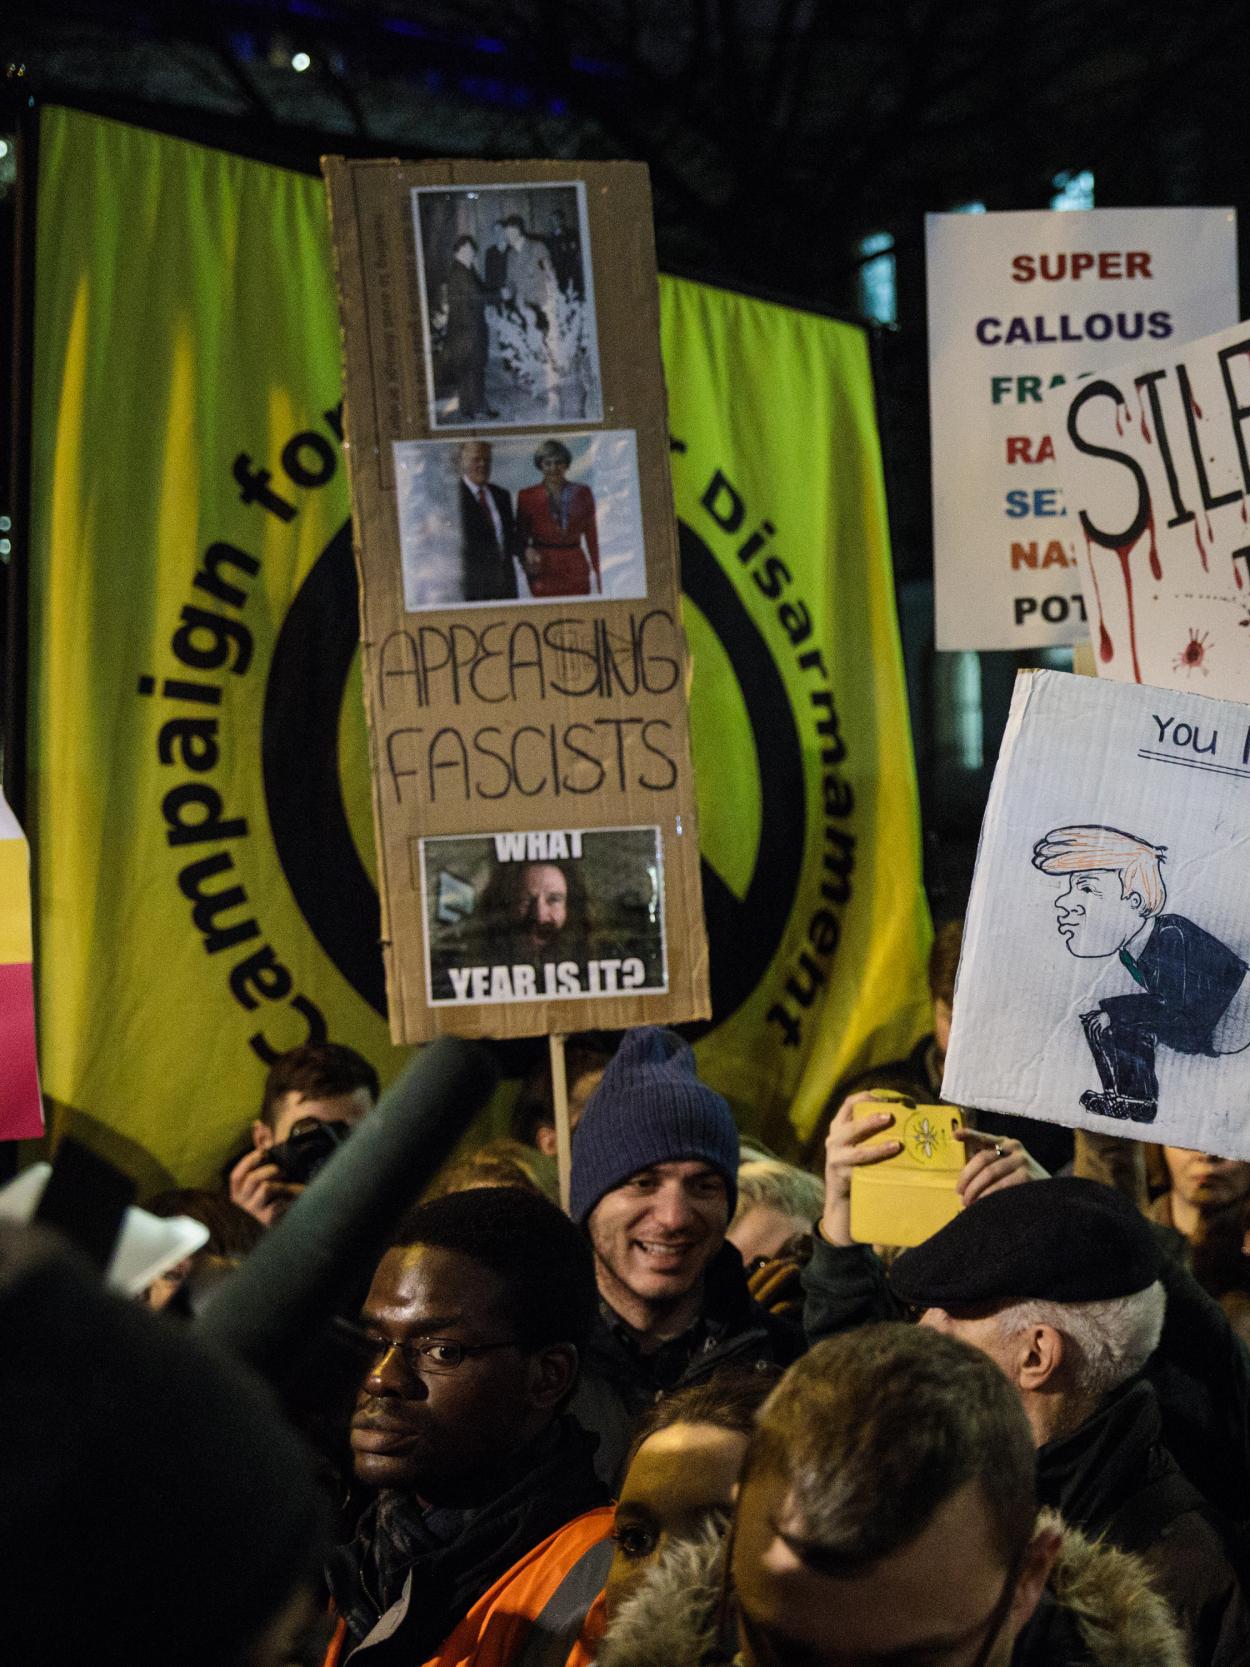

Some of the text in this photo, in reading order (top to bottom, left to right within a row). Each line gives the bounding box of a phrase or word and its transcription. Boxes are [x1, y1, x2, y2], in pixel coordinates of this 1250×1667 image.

[1012, 252, 1153, 283] SUPER
[976, 312, 1173, 346] CALLOUS
[380, 609, 681, 709] APPEASING
[1151, 714, 1218, 755] YOU
[137, 539, 328, 1069] Campaign
[701, 469, 859, 1047] Disarmament
[387, 717, 678, 804] FASCISTS
[494, 831, 584, 862] WHAT
[448, 958, 646, 1000] YEAR IS IT?
